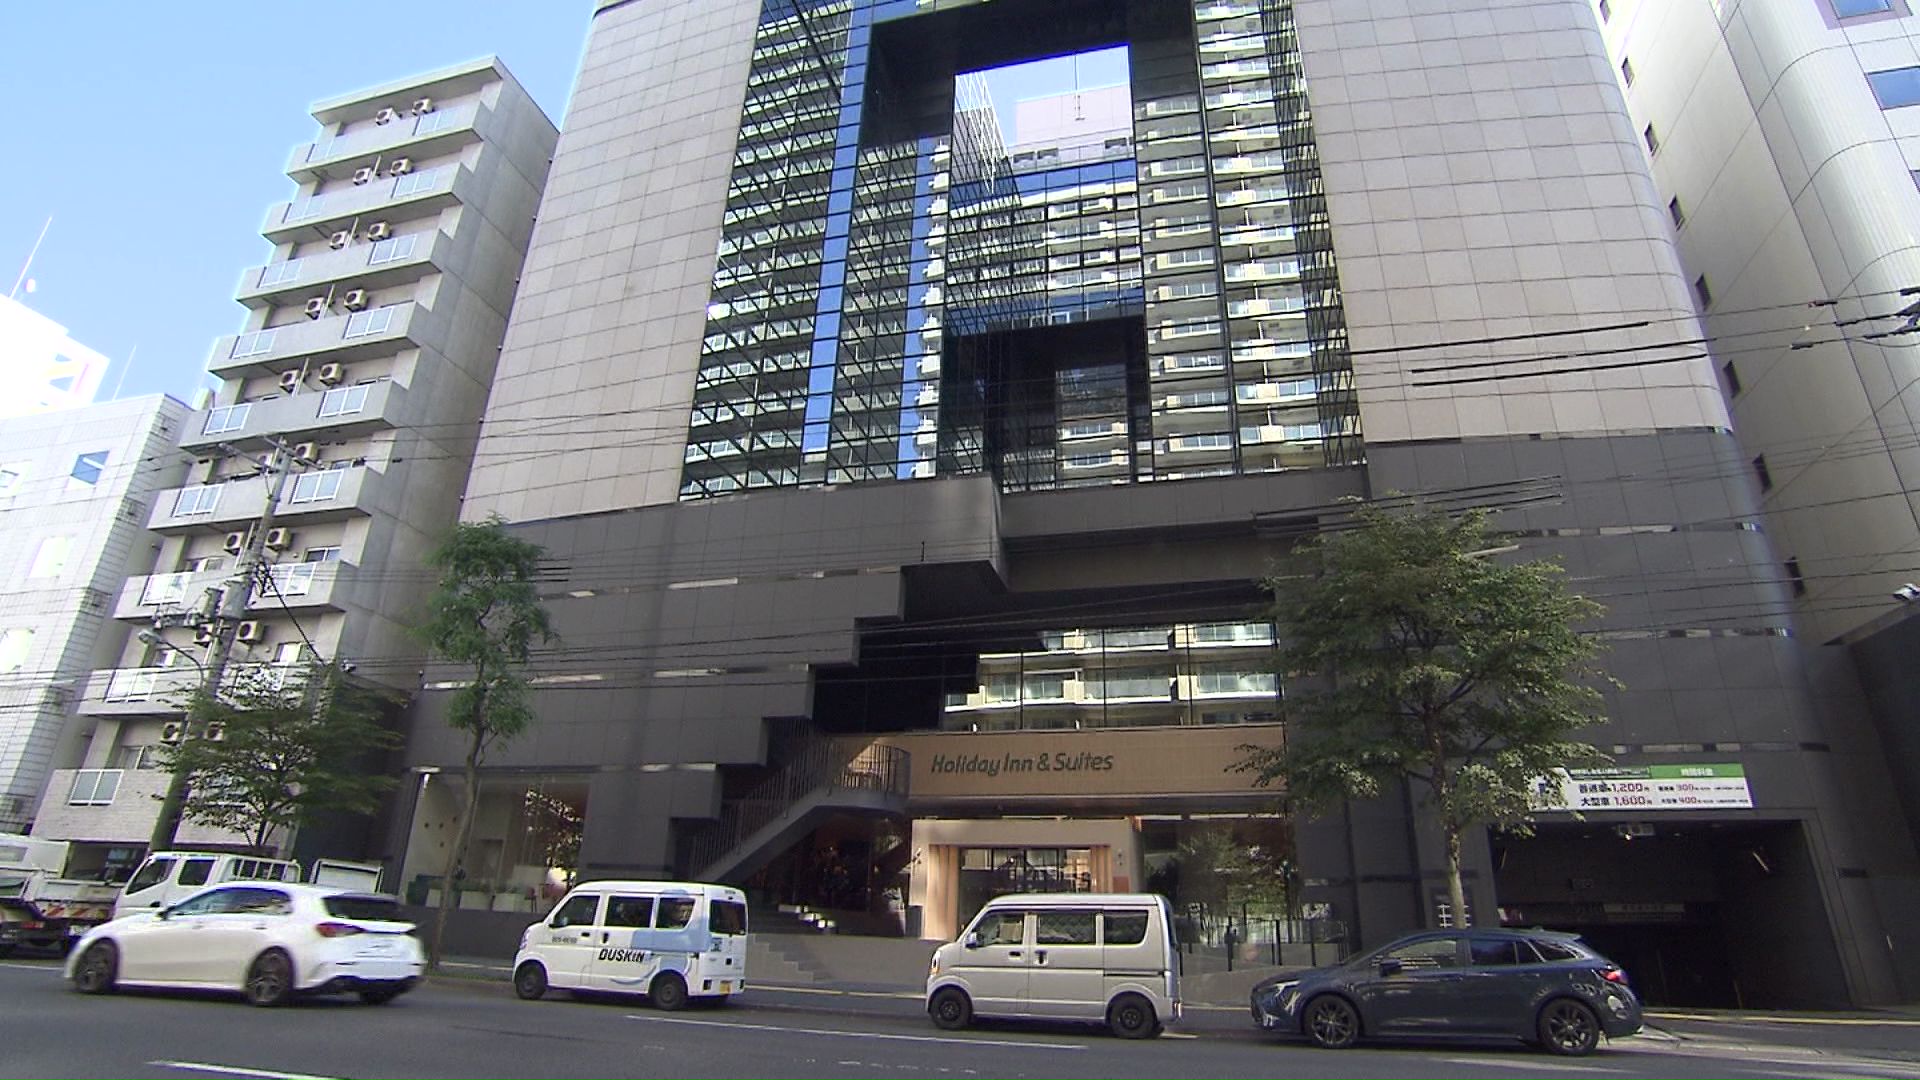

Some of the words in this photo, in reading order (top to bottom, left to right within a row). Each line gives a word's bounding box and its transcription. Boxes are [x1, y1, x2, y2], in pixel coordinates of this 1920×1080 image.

[931, 754, 1000, 776] Holiday
[1003, 753, 1033, 772] Inn
[1037, 753, 1049, 772] &
[1053, 752, 1114, 772] Suites
[598, 948, 645, 963] DUSKIN
